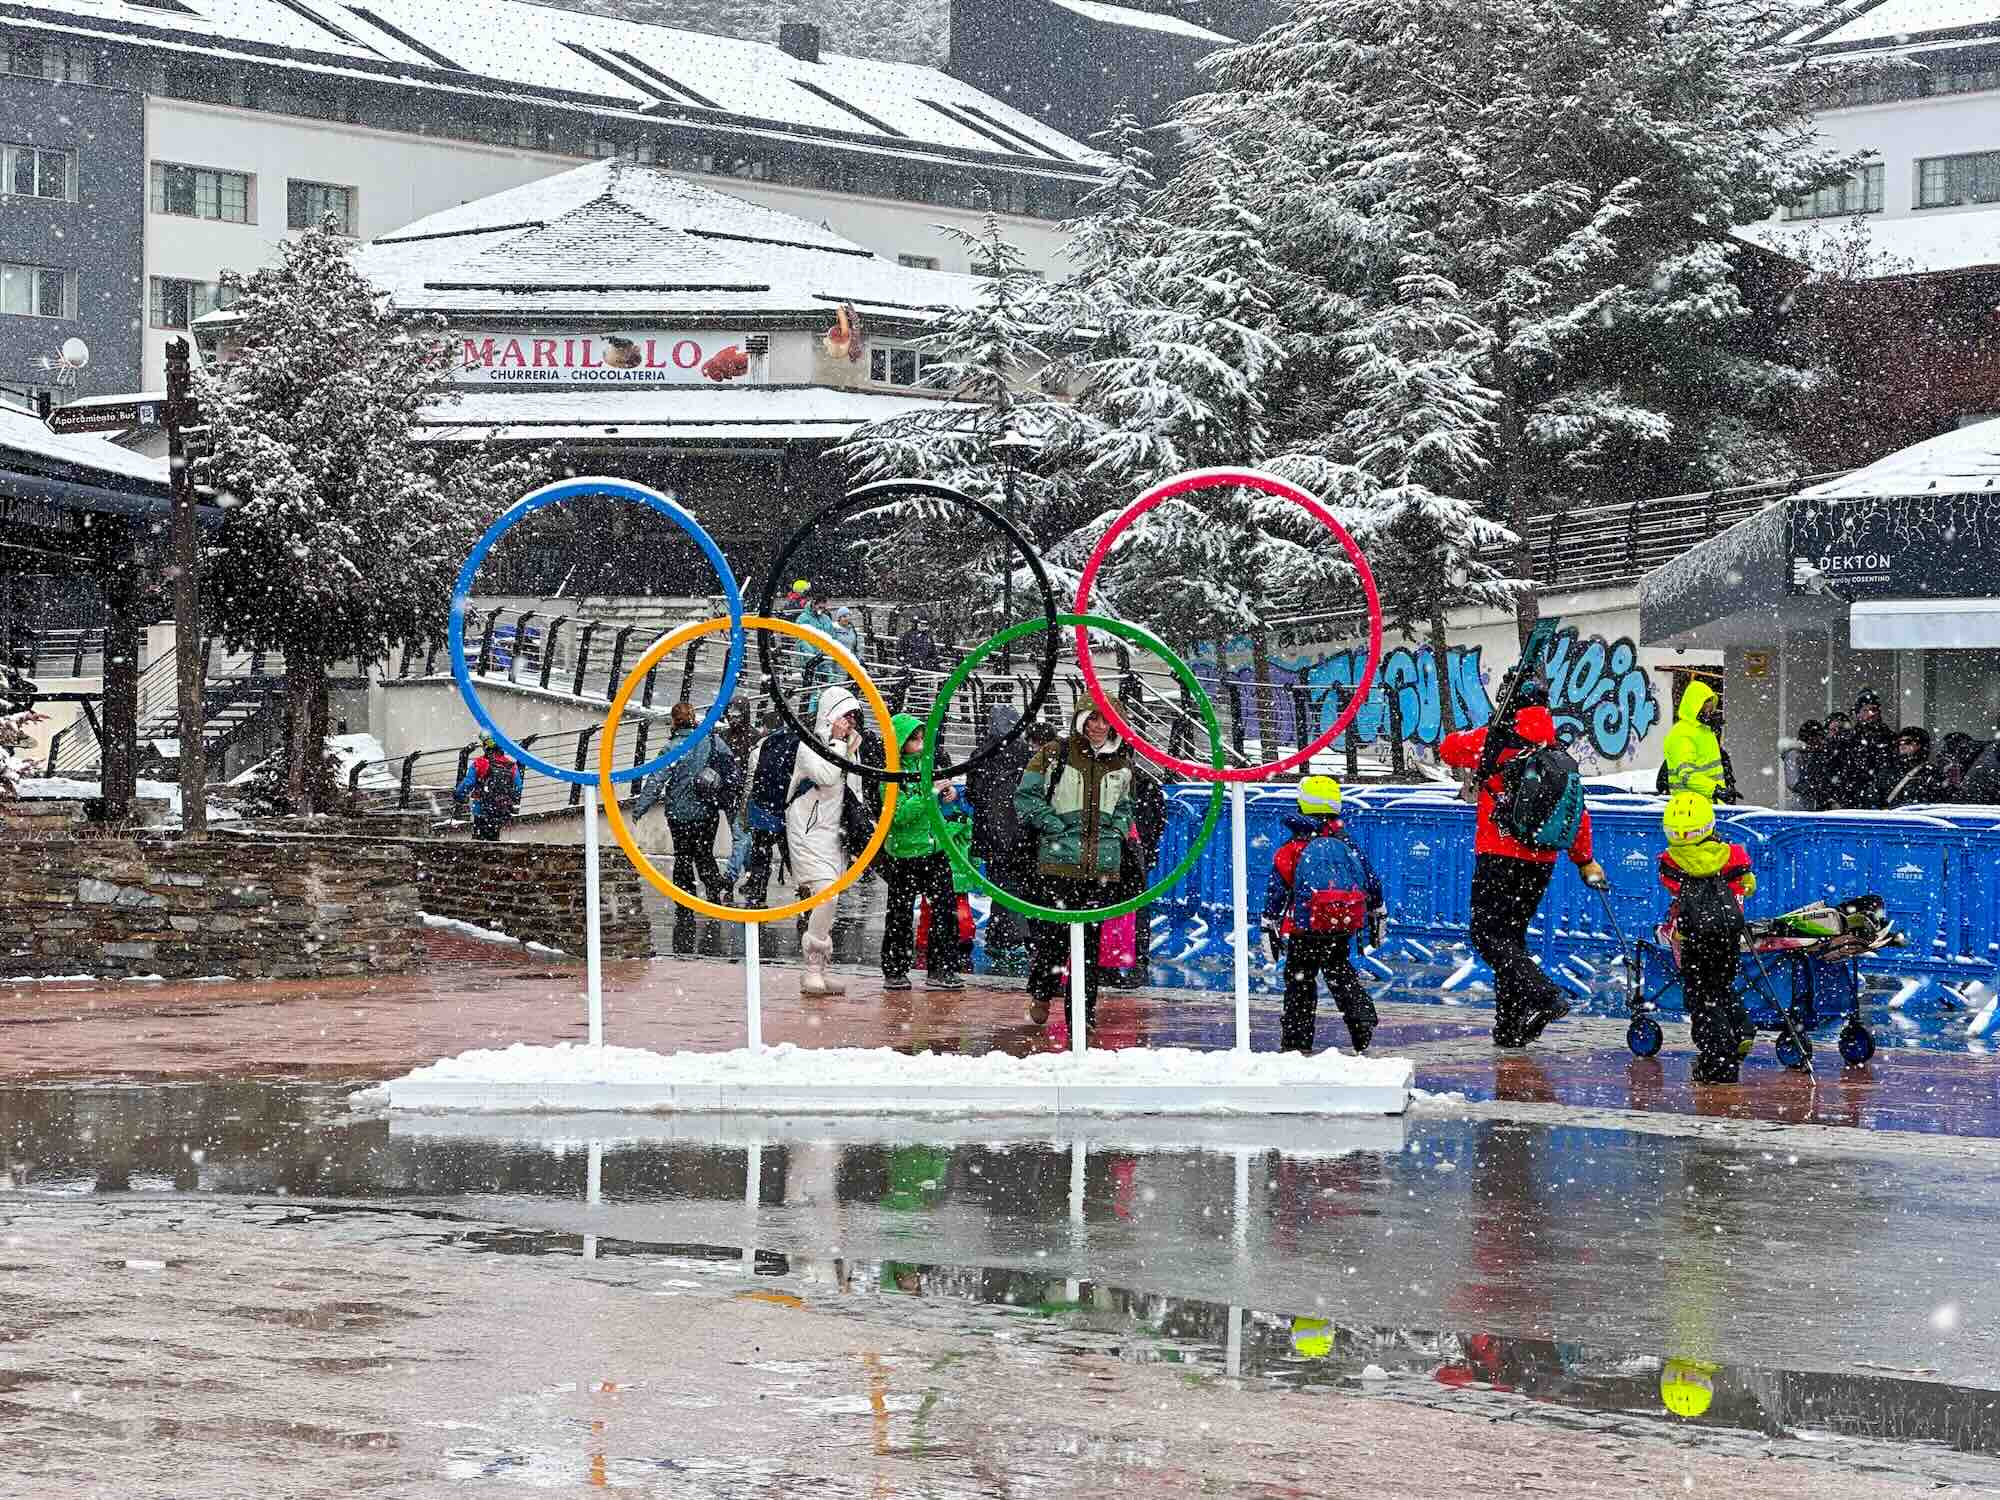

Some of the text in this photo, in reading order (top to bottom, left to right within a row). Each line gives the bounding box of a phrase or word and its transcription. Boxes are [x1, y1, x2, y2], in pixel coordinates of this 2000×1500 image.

[490, 369, 560, 380] CHURRERIA
[571, 370, 665, 381] CHOCOLATERIA
[119, 411, 137, 420] Bus
[1820, 555, 1890, 570] DEKTON
